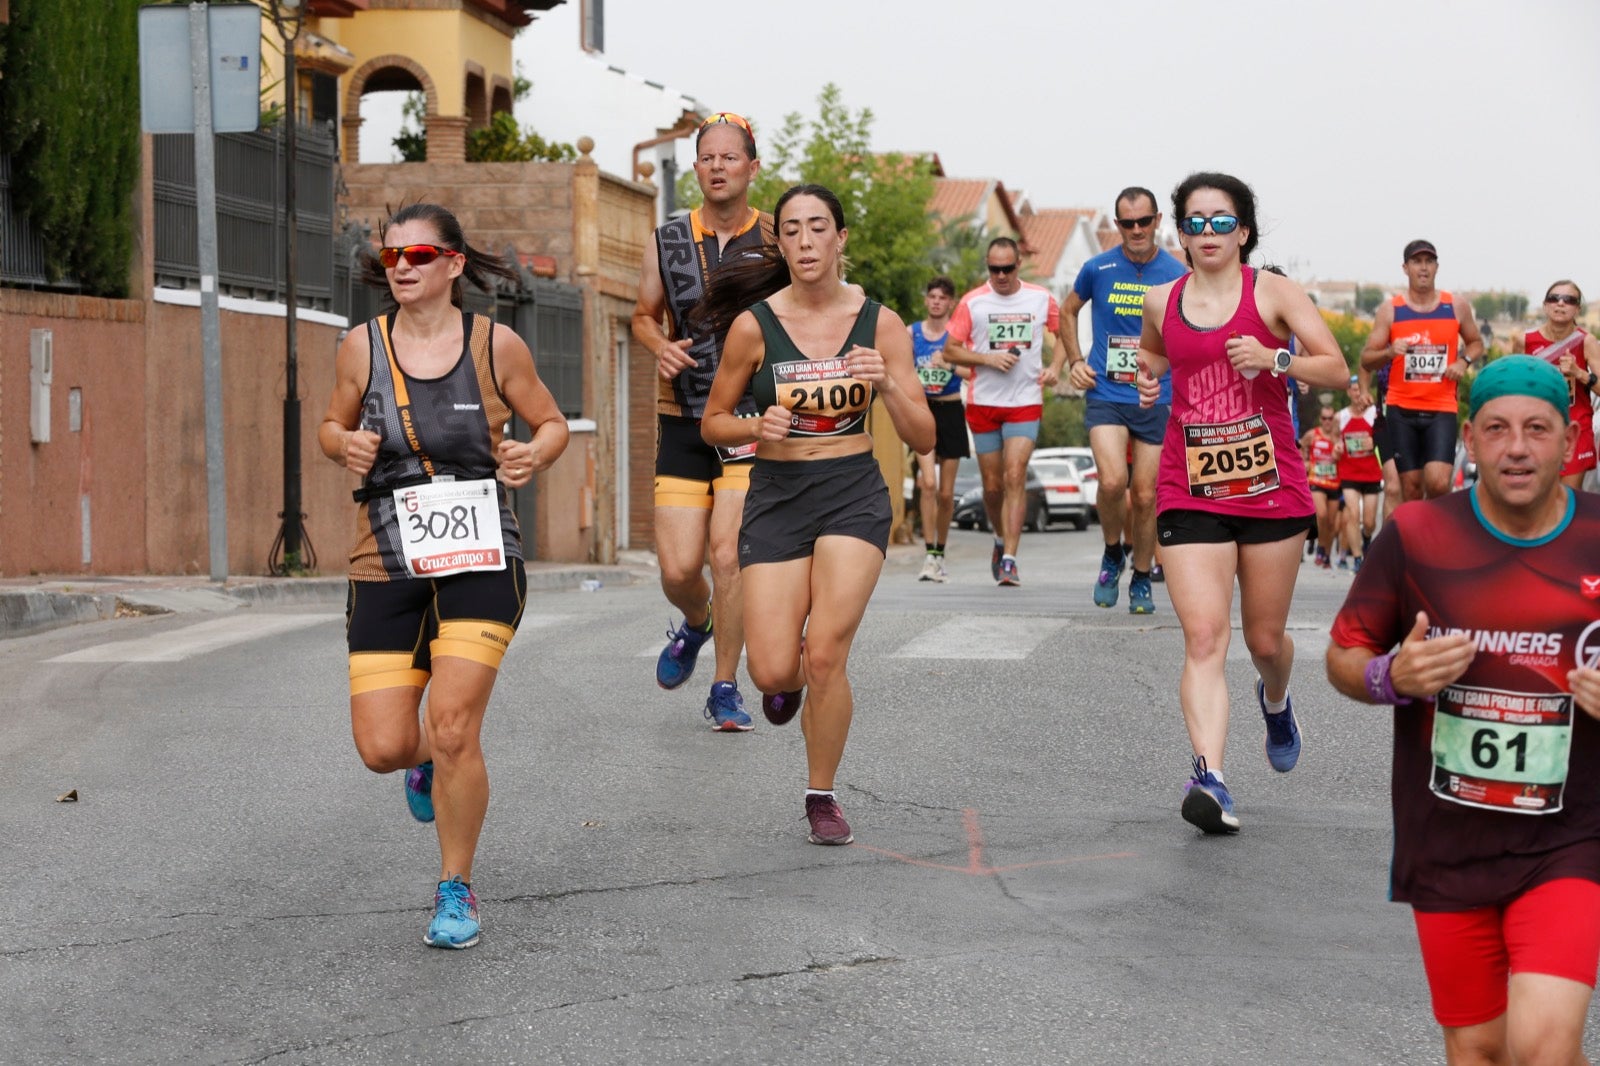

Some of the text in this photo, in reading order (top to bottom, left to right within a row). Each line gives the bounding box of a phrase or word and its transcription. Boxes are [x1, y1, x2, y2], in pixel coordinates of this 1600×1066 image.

[996, 325, 1026, 338] 217
[795, 363, 812, 373] GRAN
[812, 361, 835, 372] PREMIO
[1410, 356, 1443, 368] 3047
[923, 370, 947, 382] 952
[790, 383, 866, 411] 2100
[401, 409, 420, 452] GRANADA
[1201, 427, 1216, 438] GRAN
[1216, 425, 1238, 436] PREMIO
[1237, 422, 1245, 433] DE
[1198, 441, 1270, 477] 2055
[408, 505, 480, 544] 3081
[419, 552, 484, 570] Cruzcampo
[1509, 654, 1559, 667] GRANADA
[1464, 691, 1490, 707] GRAN
[1491, 694, 1524, 712] PREMIO
[1525, 698, 1537, 713] DE
[1471, 728, 1528, 773] 61
